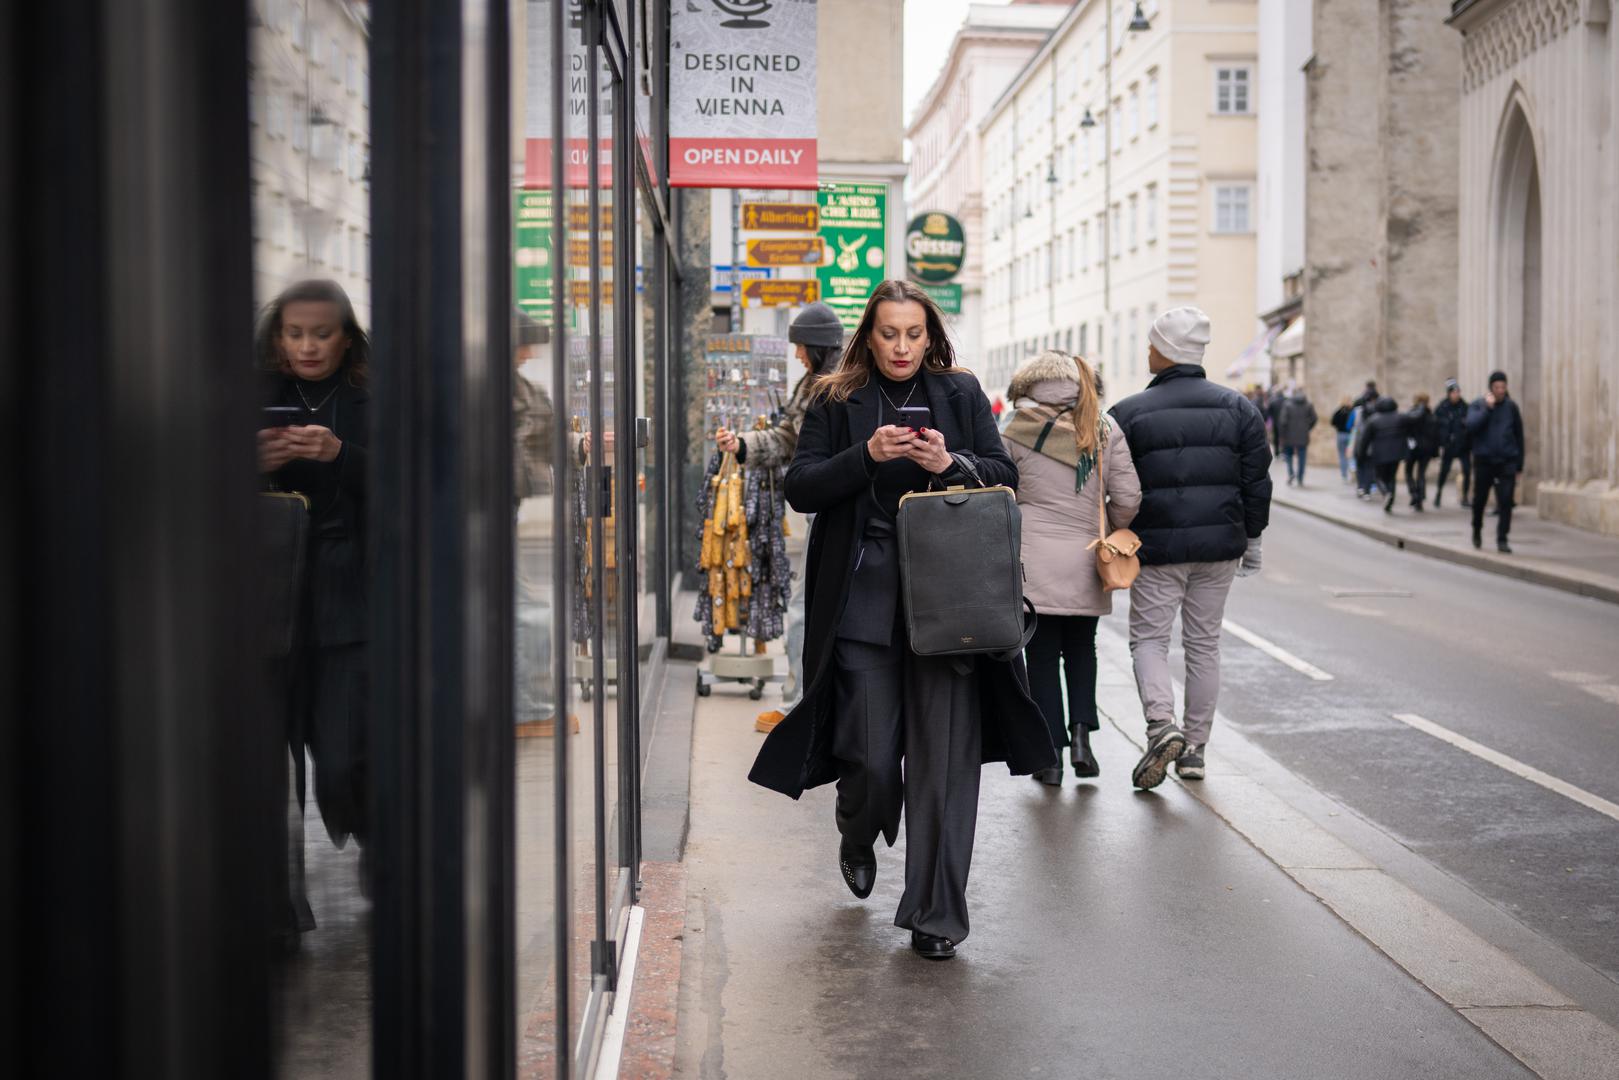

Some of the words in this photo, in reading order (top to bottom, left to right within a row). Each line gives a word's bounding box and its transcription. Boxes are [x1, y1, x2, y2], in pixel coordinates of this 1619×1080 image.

[685, 53, 800, 72] DESIGNED
[731, 76, 754, 93] IN
[696, 98, 785, 116] VIENNA
[684, 148, 740, 165] OPEN
[744, 148, 803, 165] DAILY
[760, 211, 806, 224] Albertina
